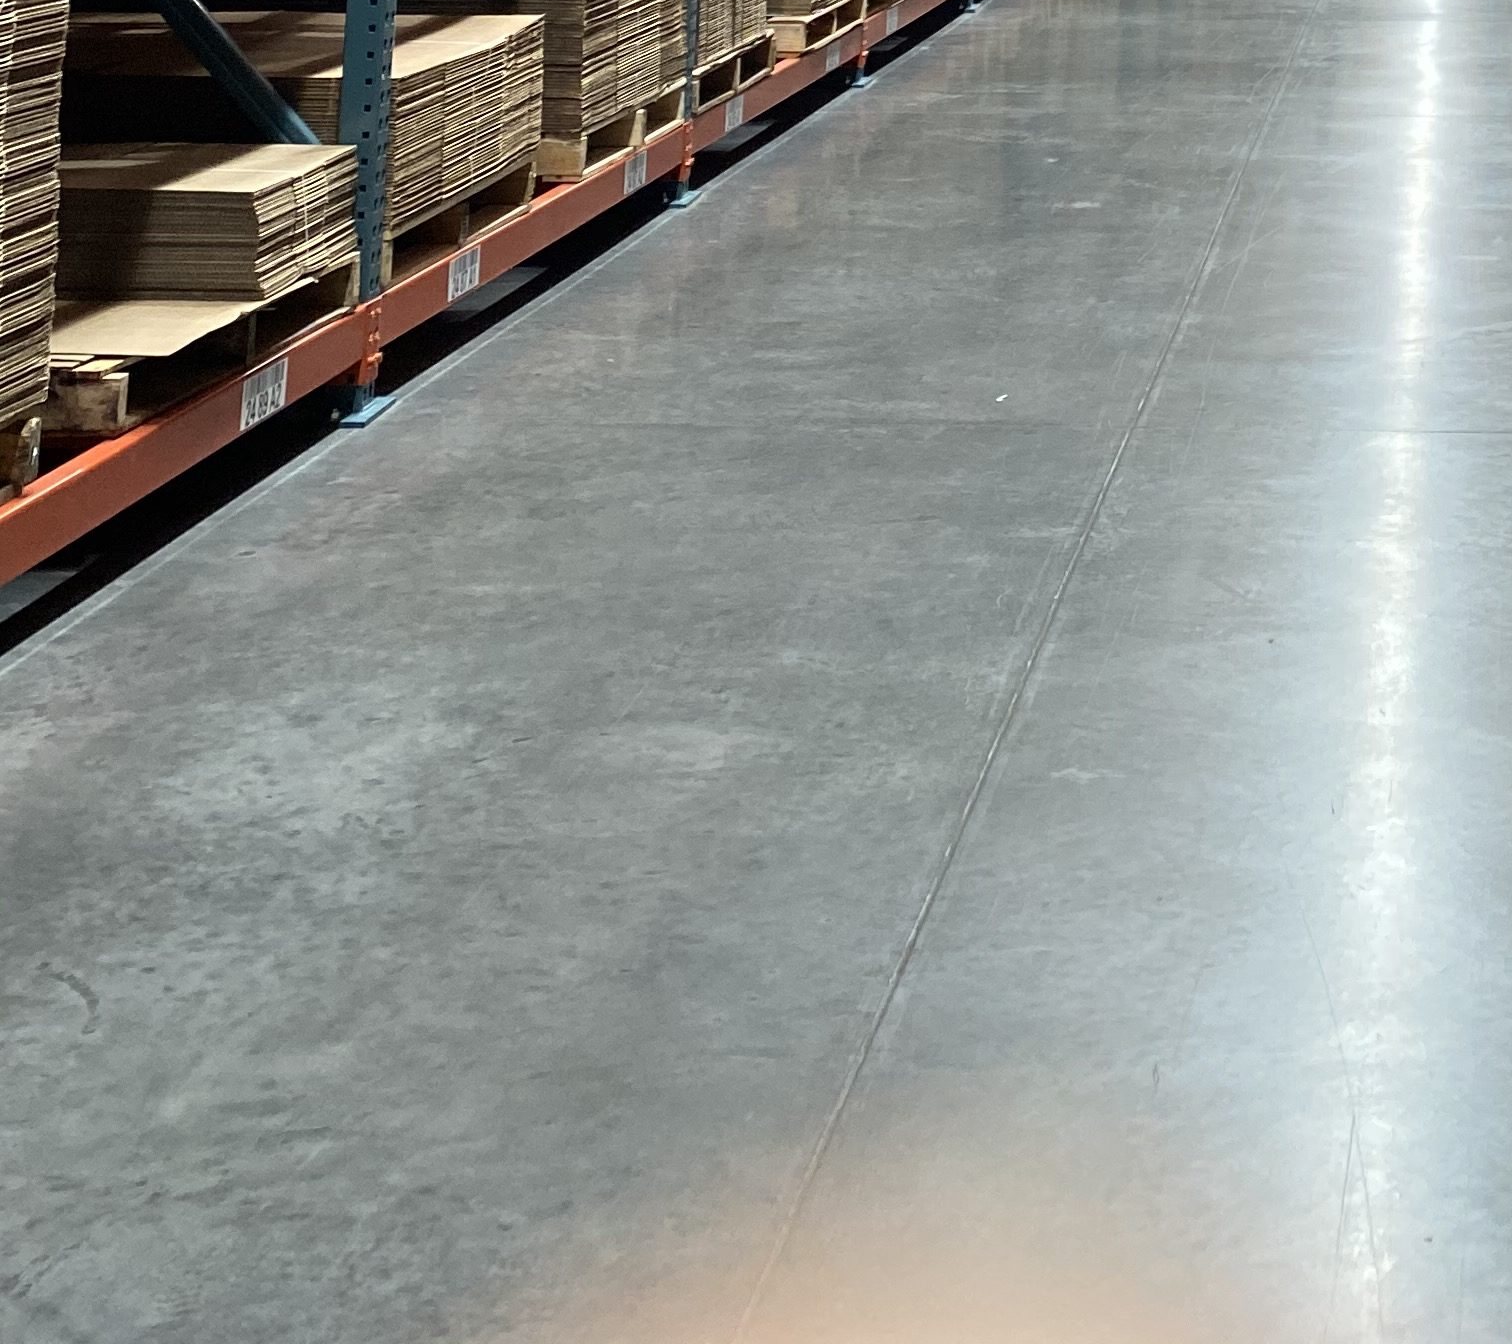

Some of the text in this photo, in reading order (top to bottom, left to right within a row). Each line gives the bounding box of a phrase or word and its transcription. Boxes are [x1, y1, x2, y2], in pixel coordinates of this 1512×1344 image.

[245, 382, 282, 427] 24 89 A2
